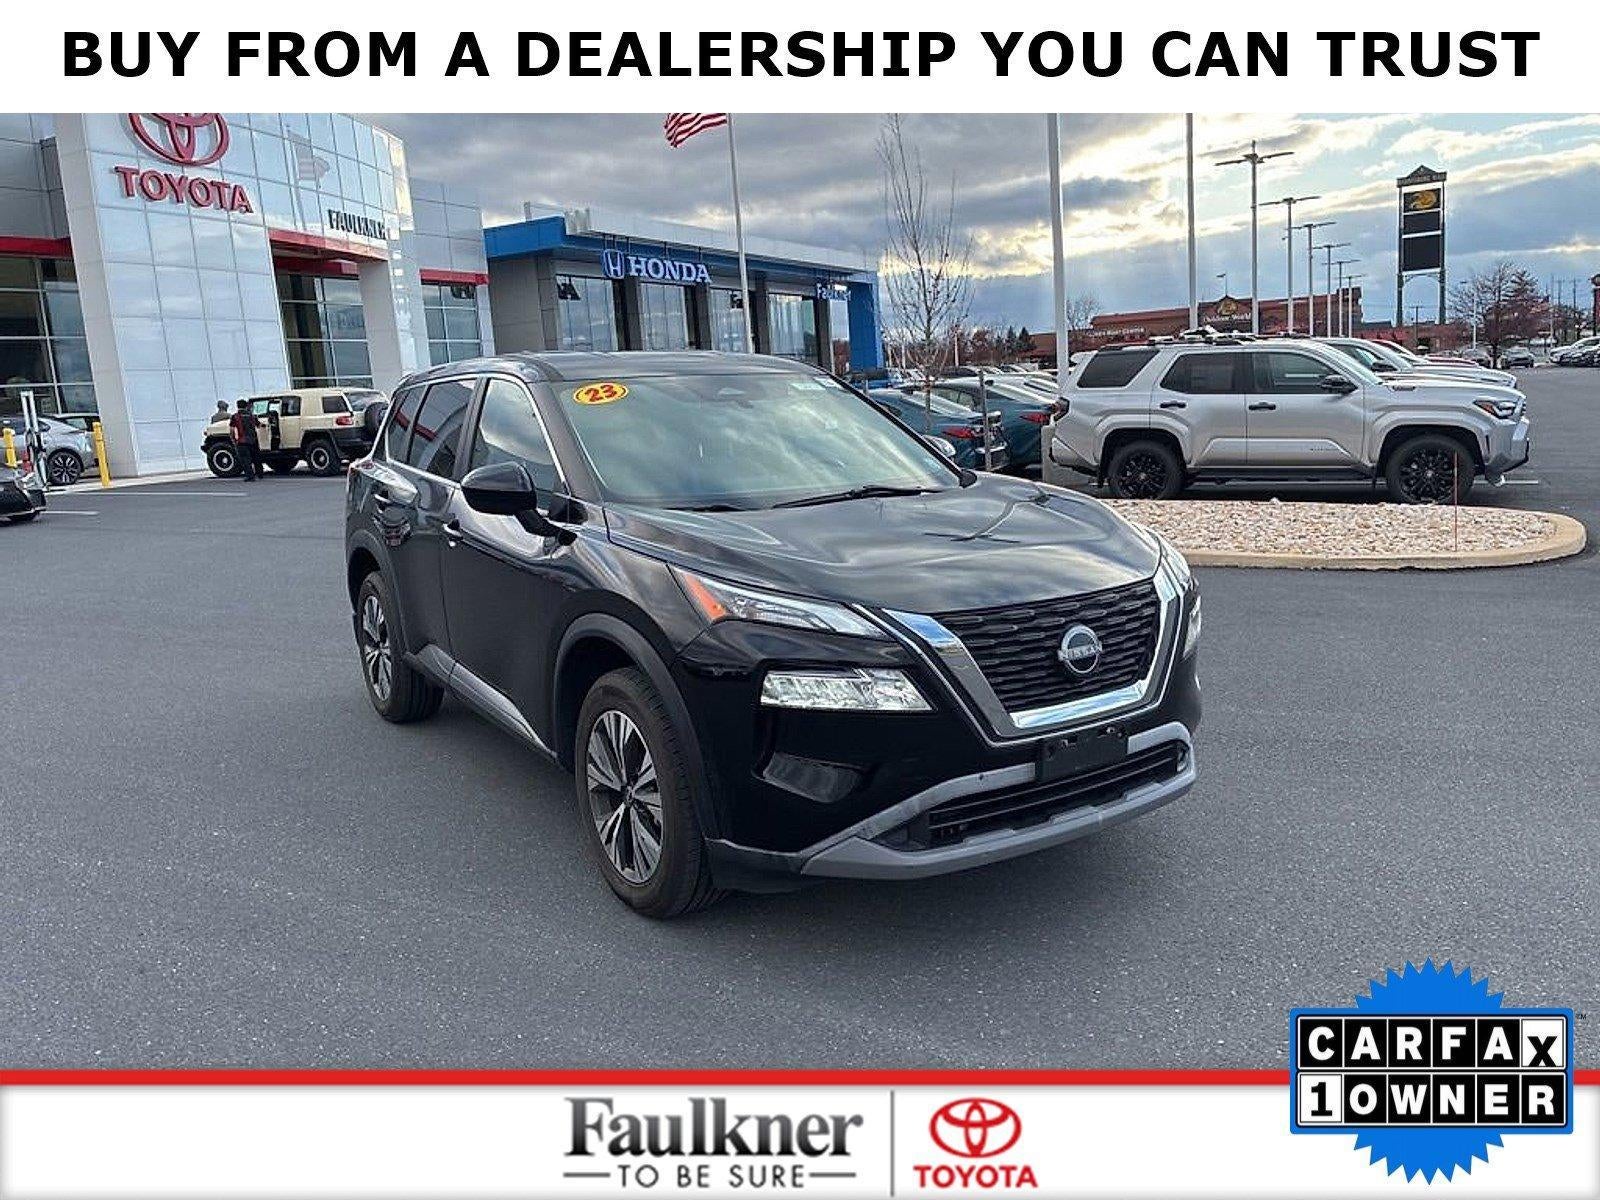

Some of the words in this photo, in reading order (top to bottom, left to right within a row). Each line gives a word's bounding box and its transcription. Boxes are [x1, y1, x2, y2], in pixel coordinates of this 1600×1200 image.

[115, 166, 252, 213] TOYOTA
[627, 255, 711, 283] HONDA
[585, 384, 617, 402] 23
